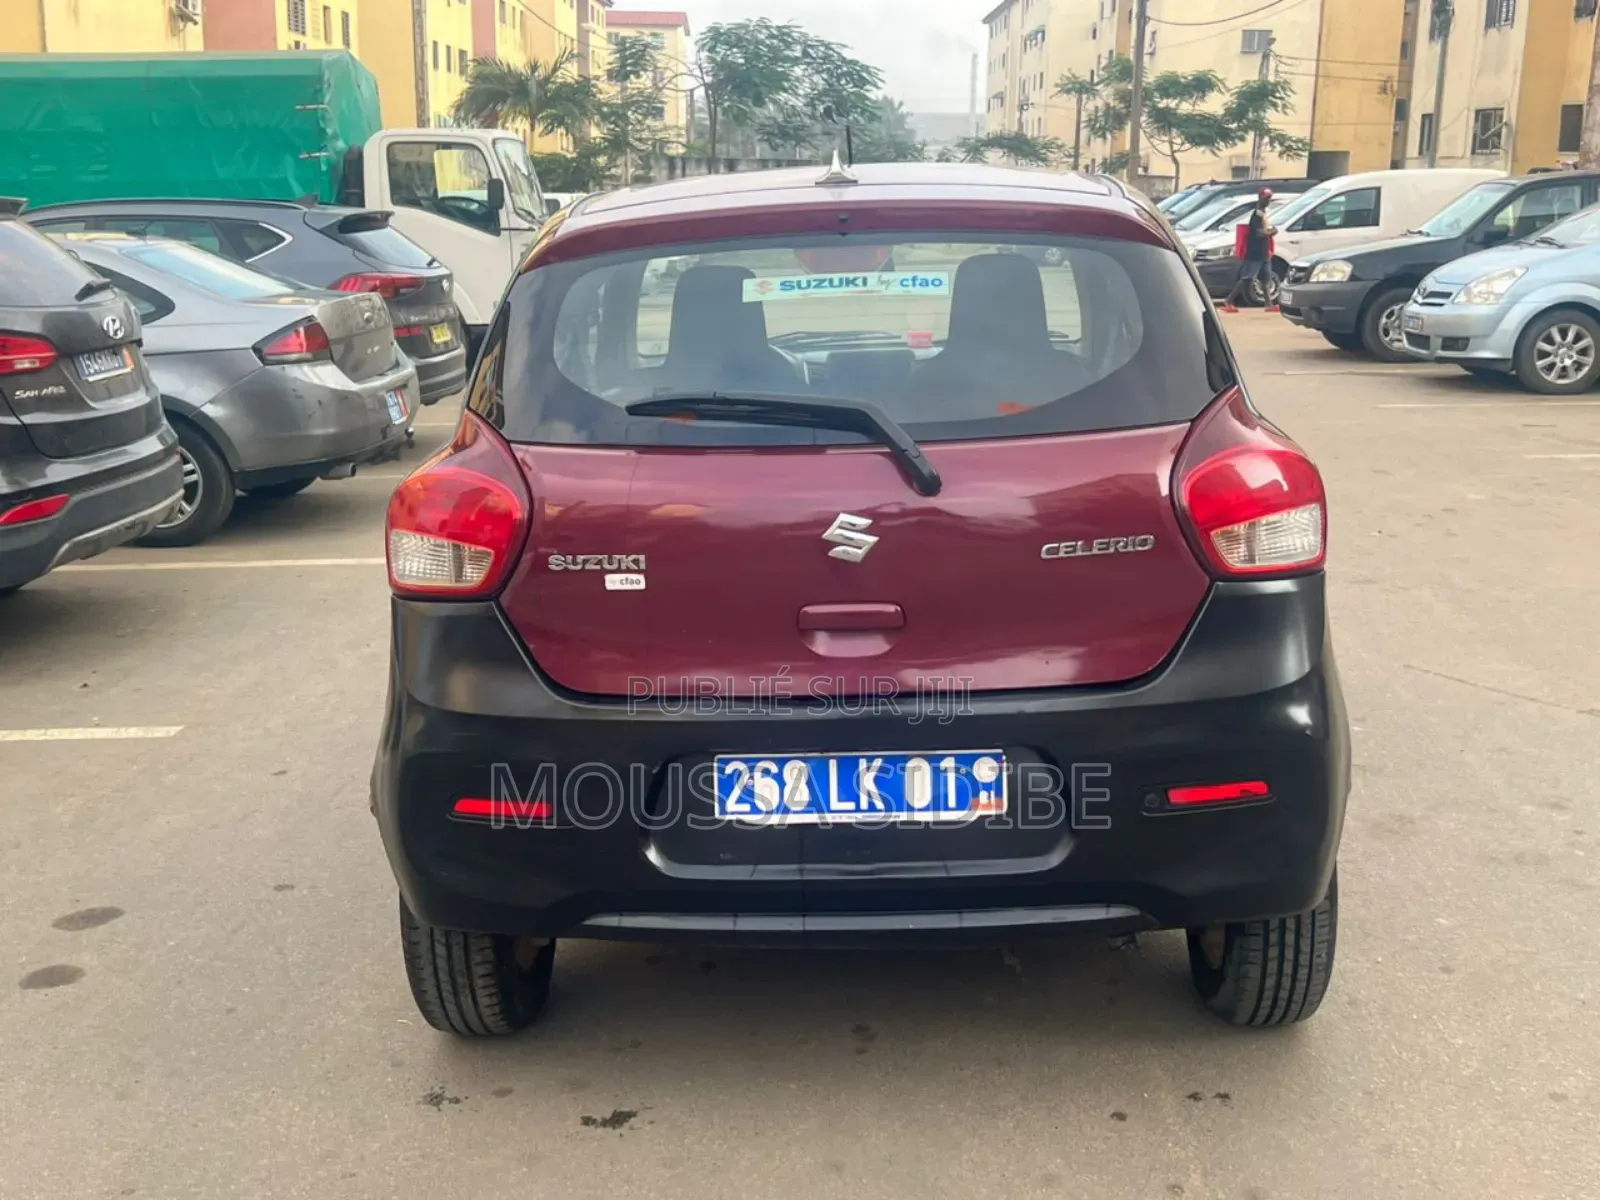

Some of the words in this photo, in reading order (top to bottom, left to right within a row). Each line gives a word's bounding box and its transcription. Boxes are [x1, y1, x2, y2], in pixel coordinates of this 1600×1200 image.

[779, 275, 868, 291] SUZUKI
[899, 274, 944, 288] cfao
[1040, 534, 1155, 559] CELERIO
[548, 554, 646, 570] SUZUKI
[619, 577, 641, 586] cfao
[724, 759, 811, 812] 268
[829, 757, 885, 811] LK
[904, 756, 957, 809] 01
